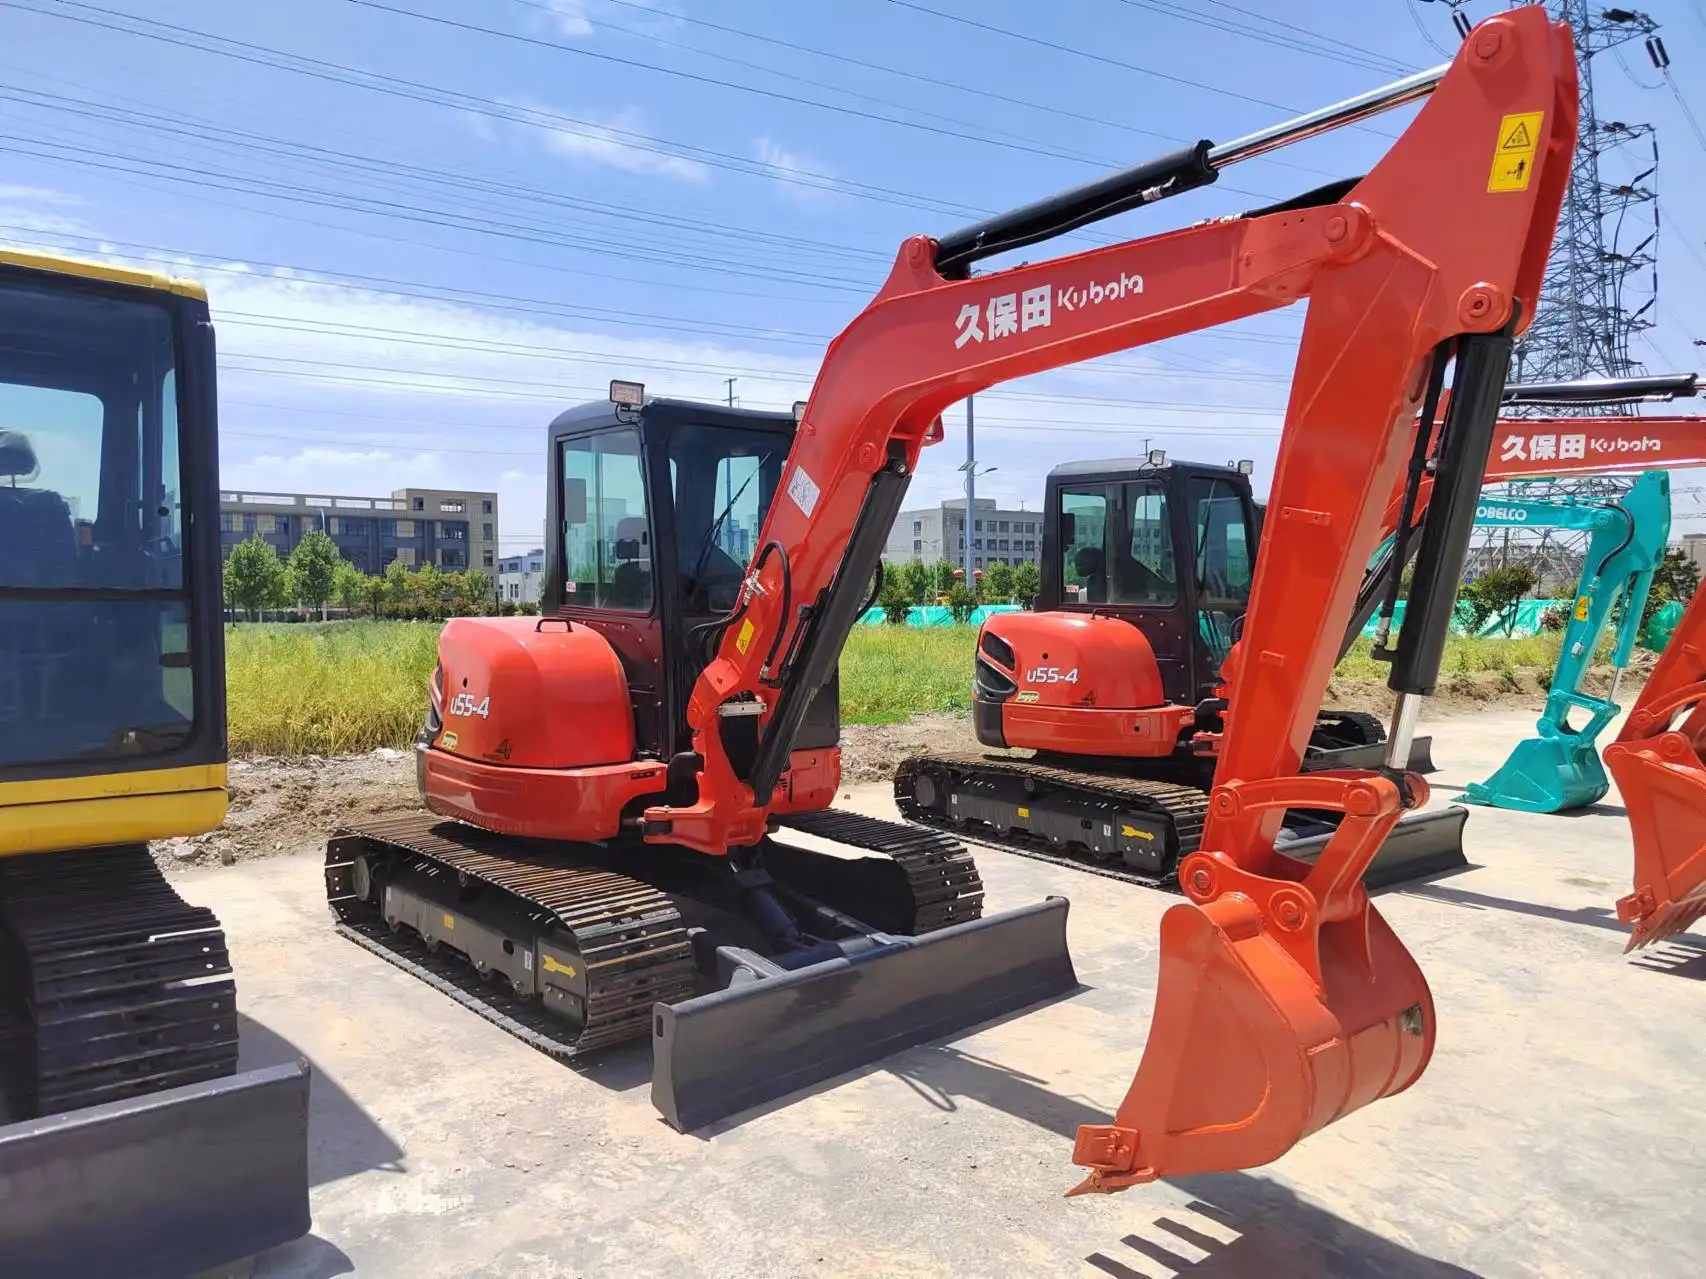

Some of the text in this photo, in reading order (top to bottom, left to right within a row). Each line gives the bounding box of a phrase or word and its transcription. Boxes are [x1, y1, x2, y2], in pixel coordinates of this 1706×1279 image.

[954, 272, 1144, 350] 久保田 Kubota
[1500, 434, 1662, 462] 久保田 Kubota
[1476, 506, 1527, 521] OBELCO
